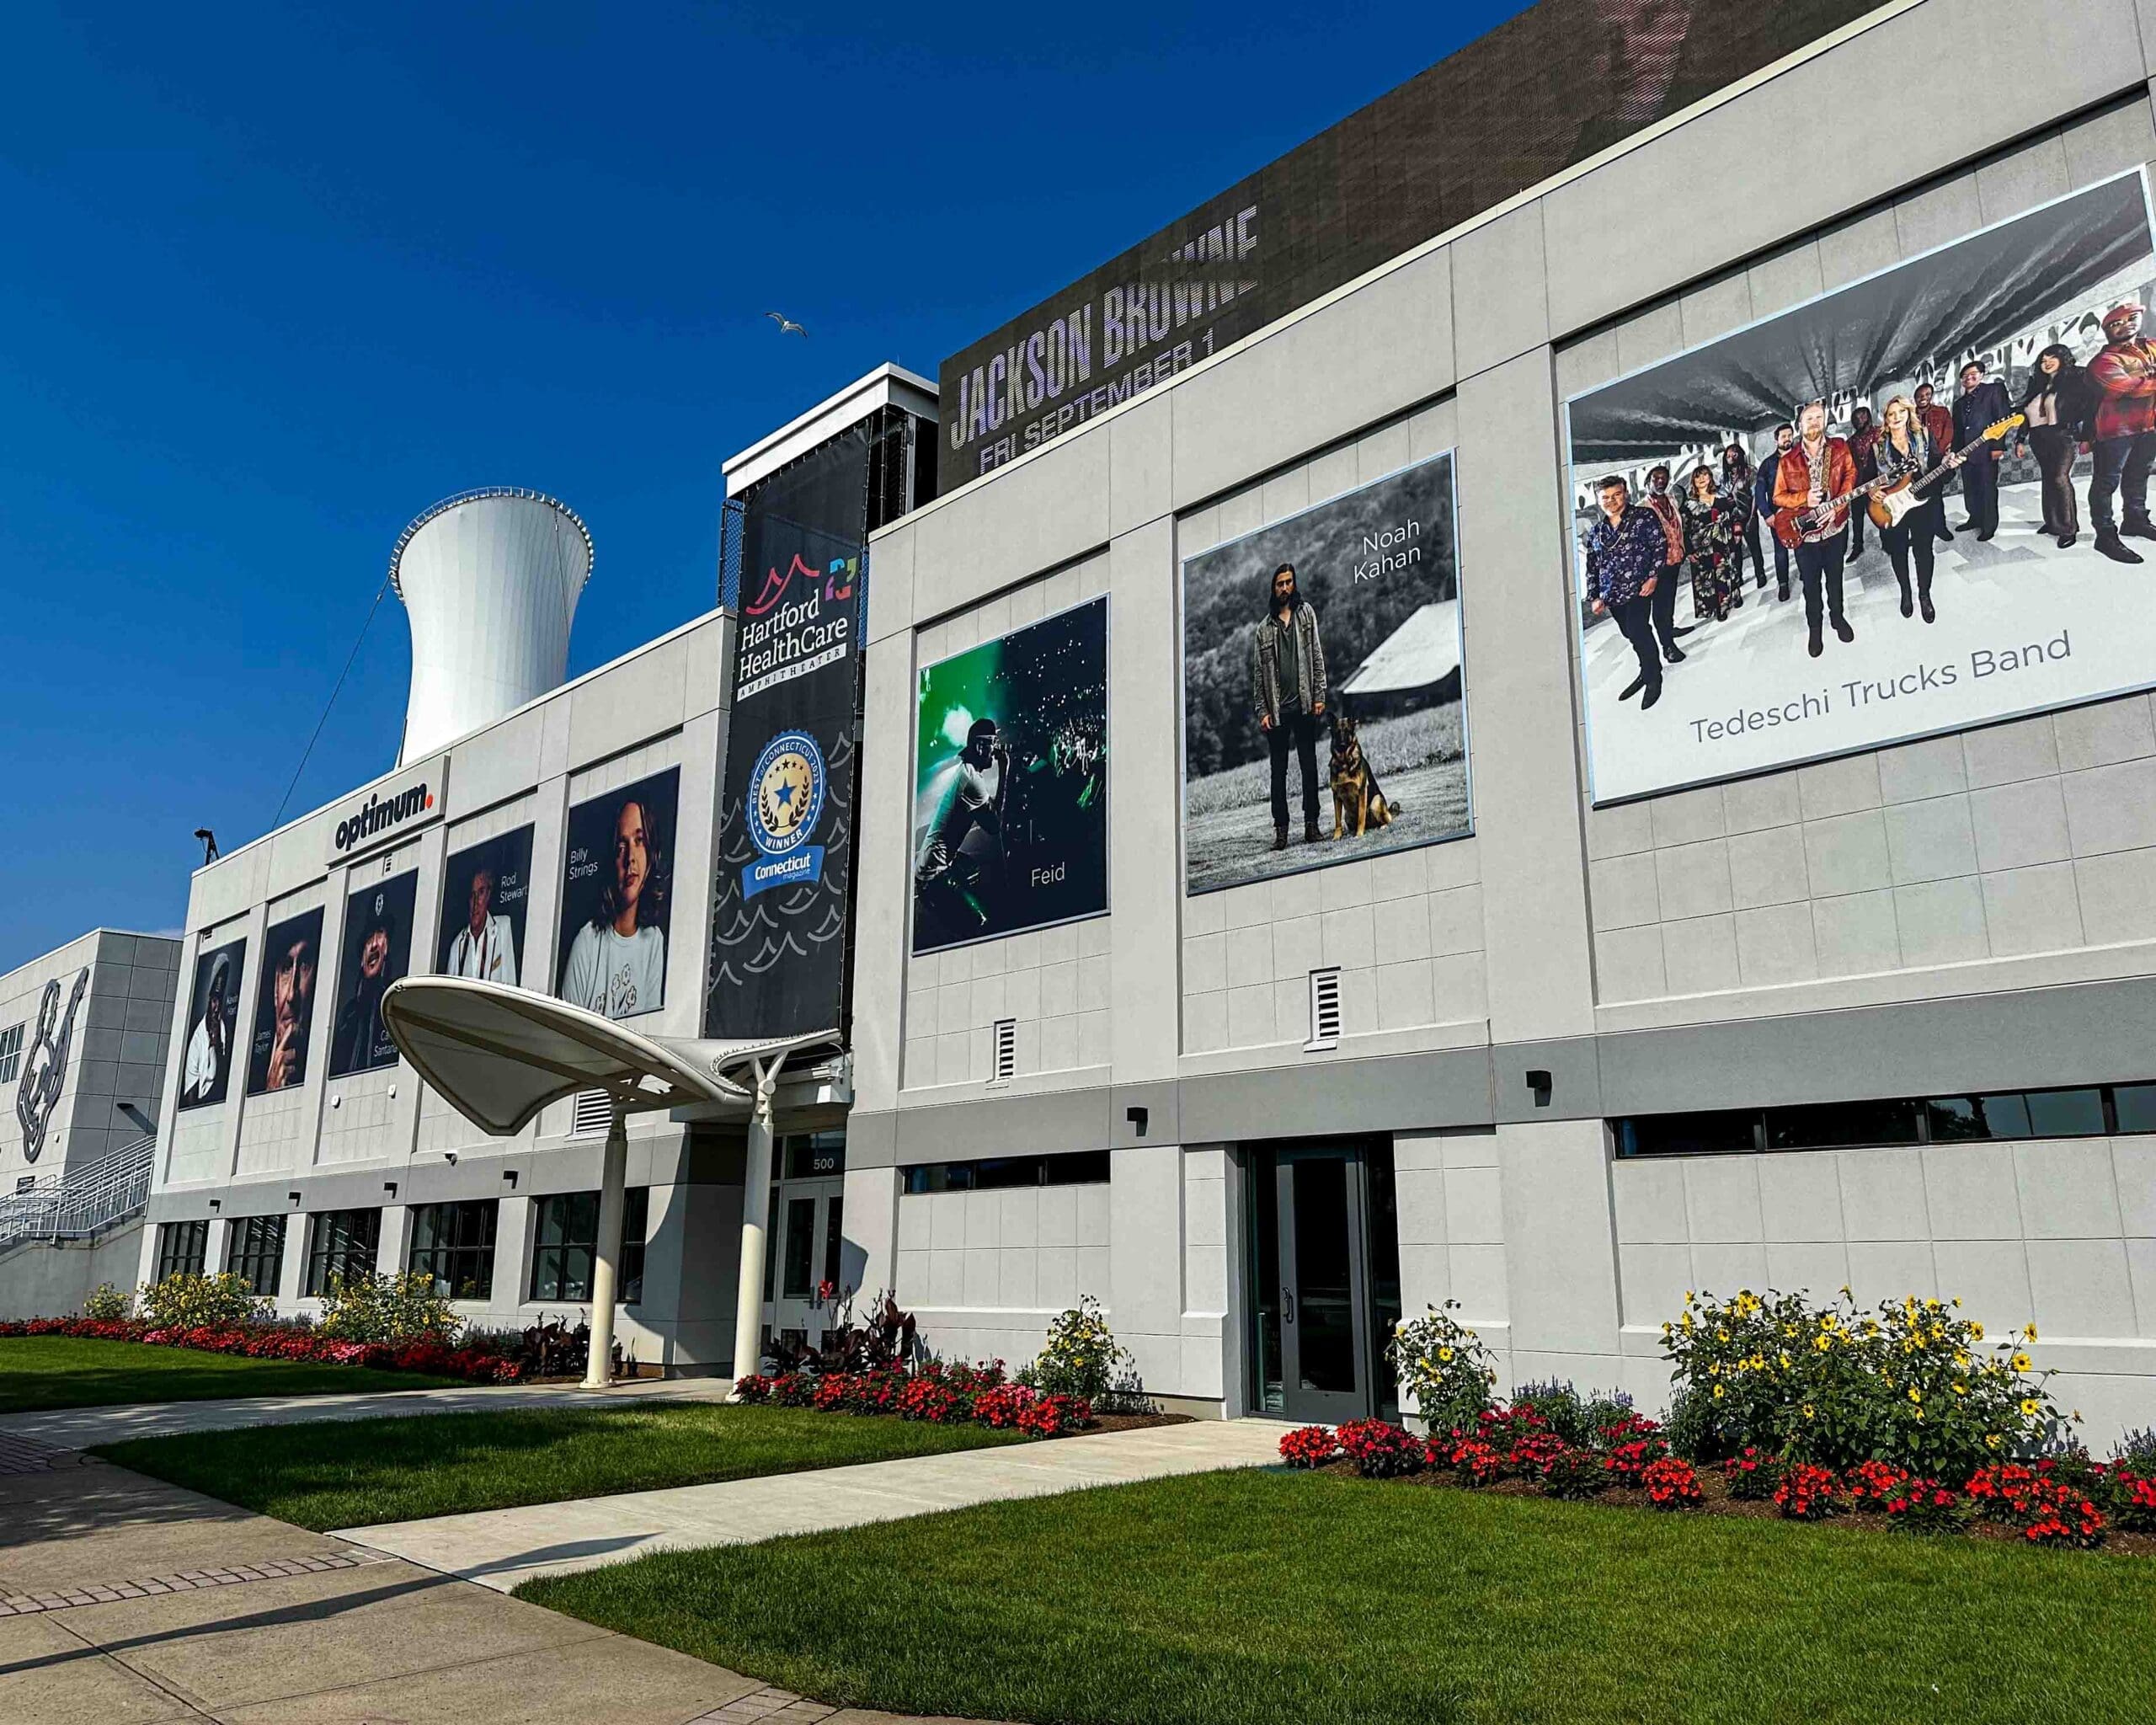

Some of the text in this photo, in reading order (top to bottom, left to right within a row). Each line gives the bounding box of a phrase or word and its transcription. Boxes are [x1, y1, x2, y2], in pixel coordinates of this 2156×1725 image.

[950, 303, 1091, 451] JACKSON
[979, 327, 1214, 476] FRI SEPTEMBER 1
[1363, 518, 1420, 556] Noah
[1353, 547, 1421, 585] Kahan
[740, 588, 820, 652] Hartford
[739, 617, 848, 683] HealthCare
[739, 647, 841, 698] AMPHITHEATER
[1689, 628, 2072, 744] Tedeschi Trucks Band
[752, 777, 761, 804] BEST
[765, 741, 814, 765] CONNECTICUT
[810, 760, 820, 785] 2023
[570, 847, 588, 863] Billy
[765, 829, 803, 851] WINNER
[501, 872, 516, 888] Rod
[568, 862, 598, 880] Strings
[755, 852, 811, 881] Connecticut
[782, 868, 811, 881] magazine
[1032, 861, 1065, 887] Feid
[499, 884, 528, 904] Stewart
[814, 1157, 835, 1170] 500
